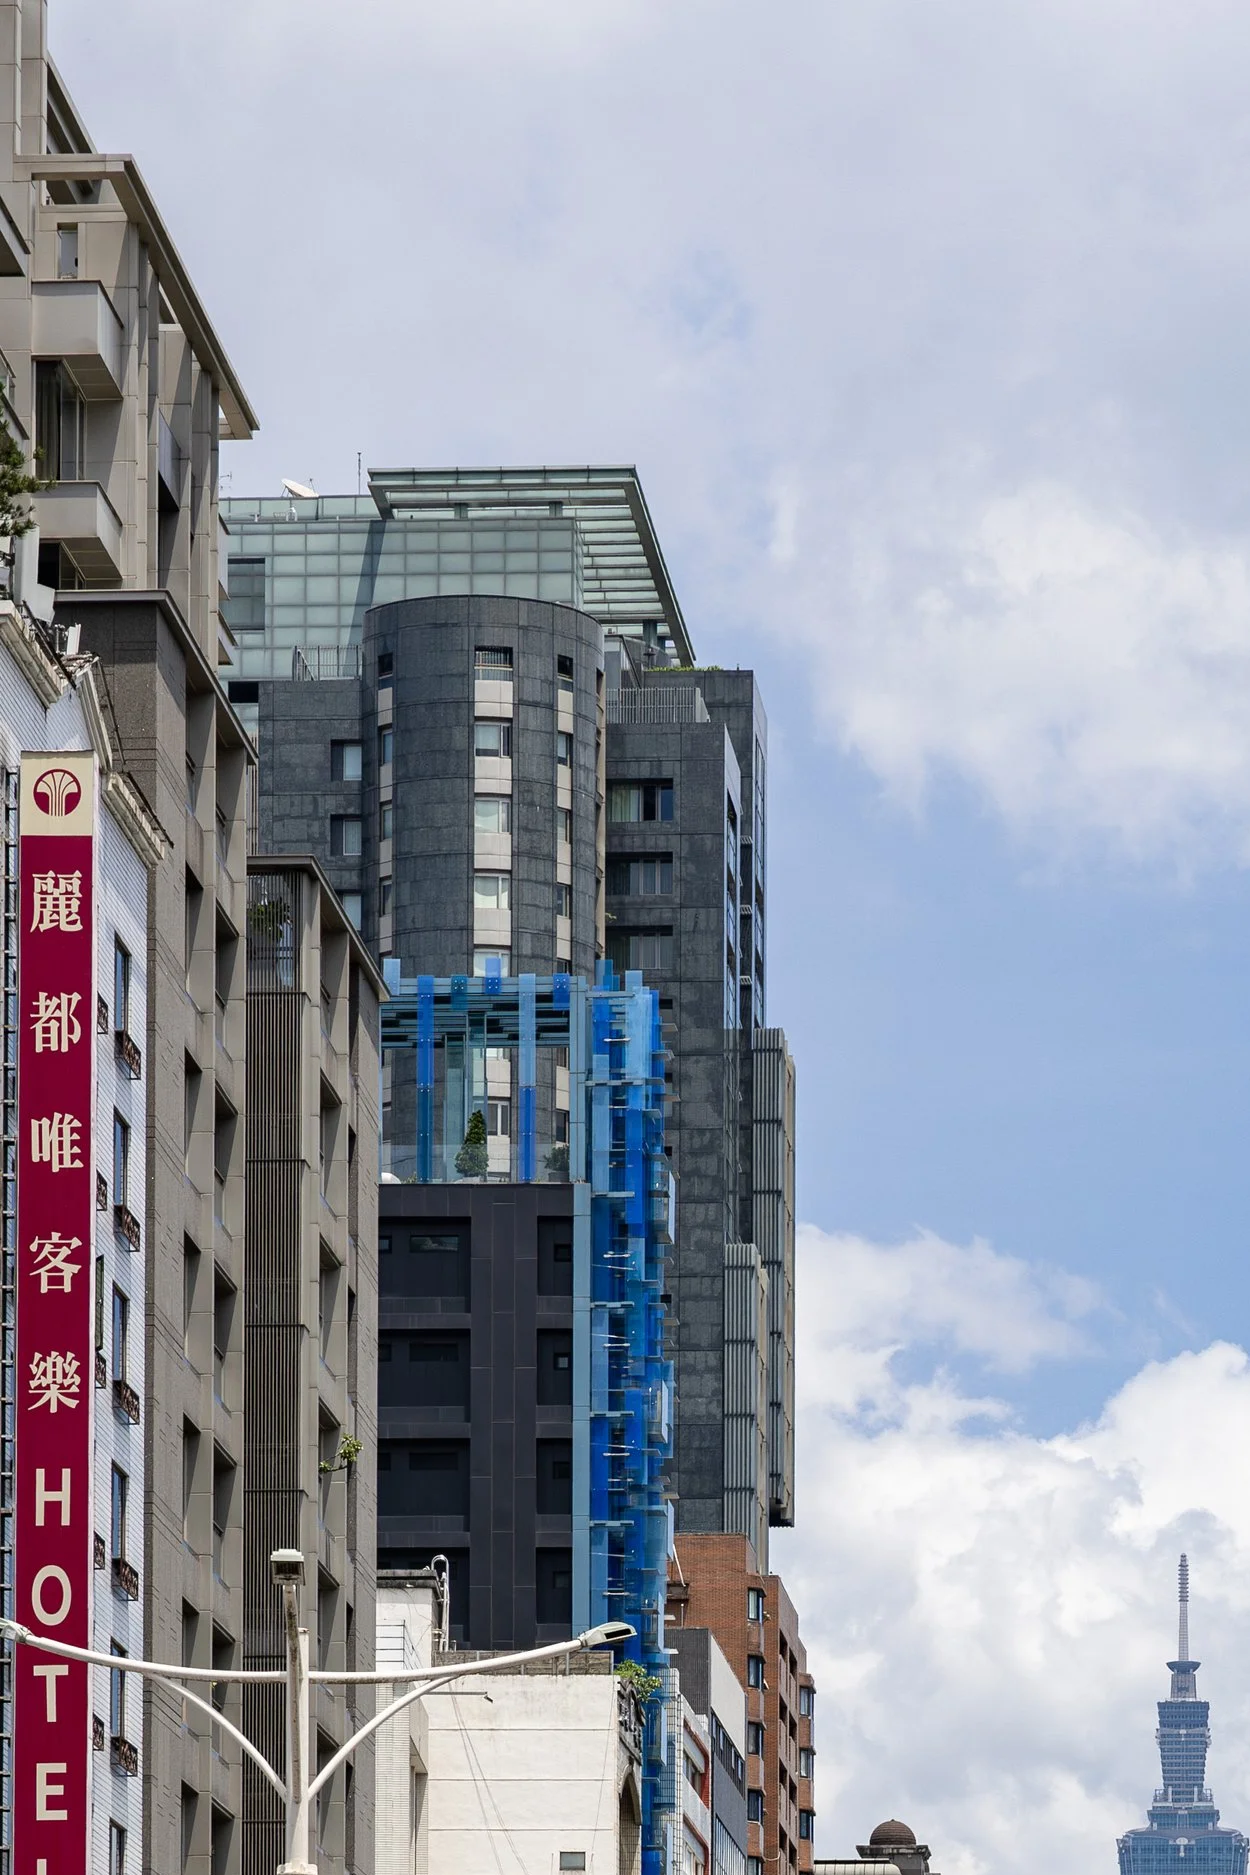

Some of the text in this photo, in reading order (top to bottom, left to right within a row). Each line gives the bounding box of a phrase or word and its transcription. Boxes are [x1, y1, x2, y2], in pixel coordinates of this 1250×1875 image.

[28, 871, 84, 1413] 麗都唯客樂
